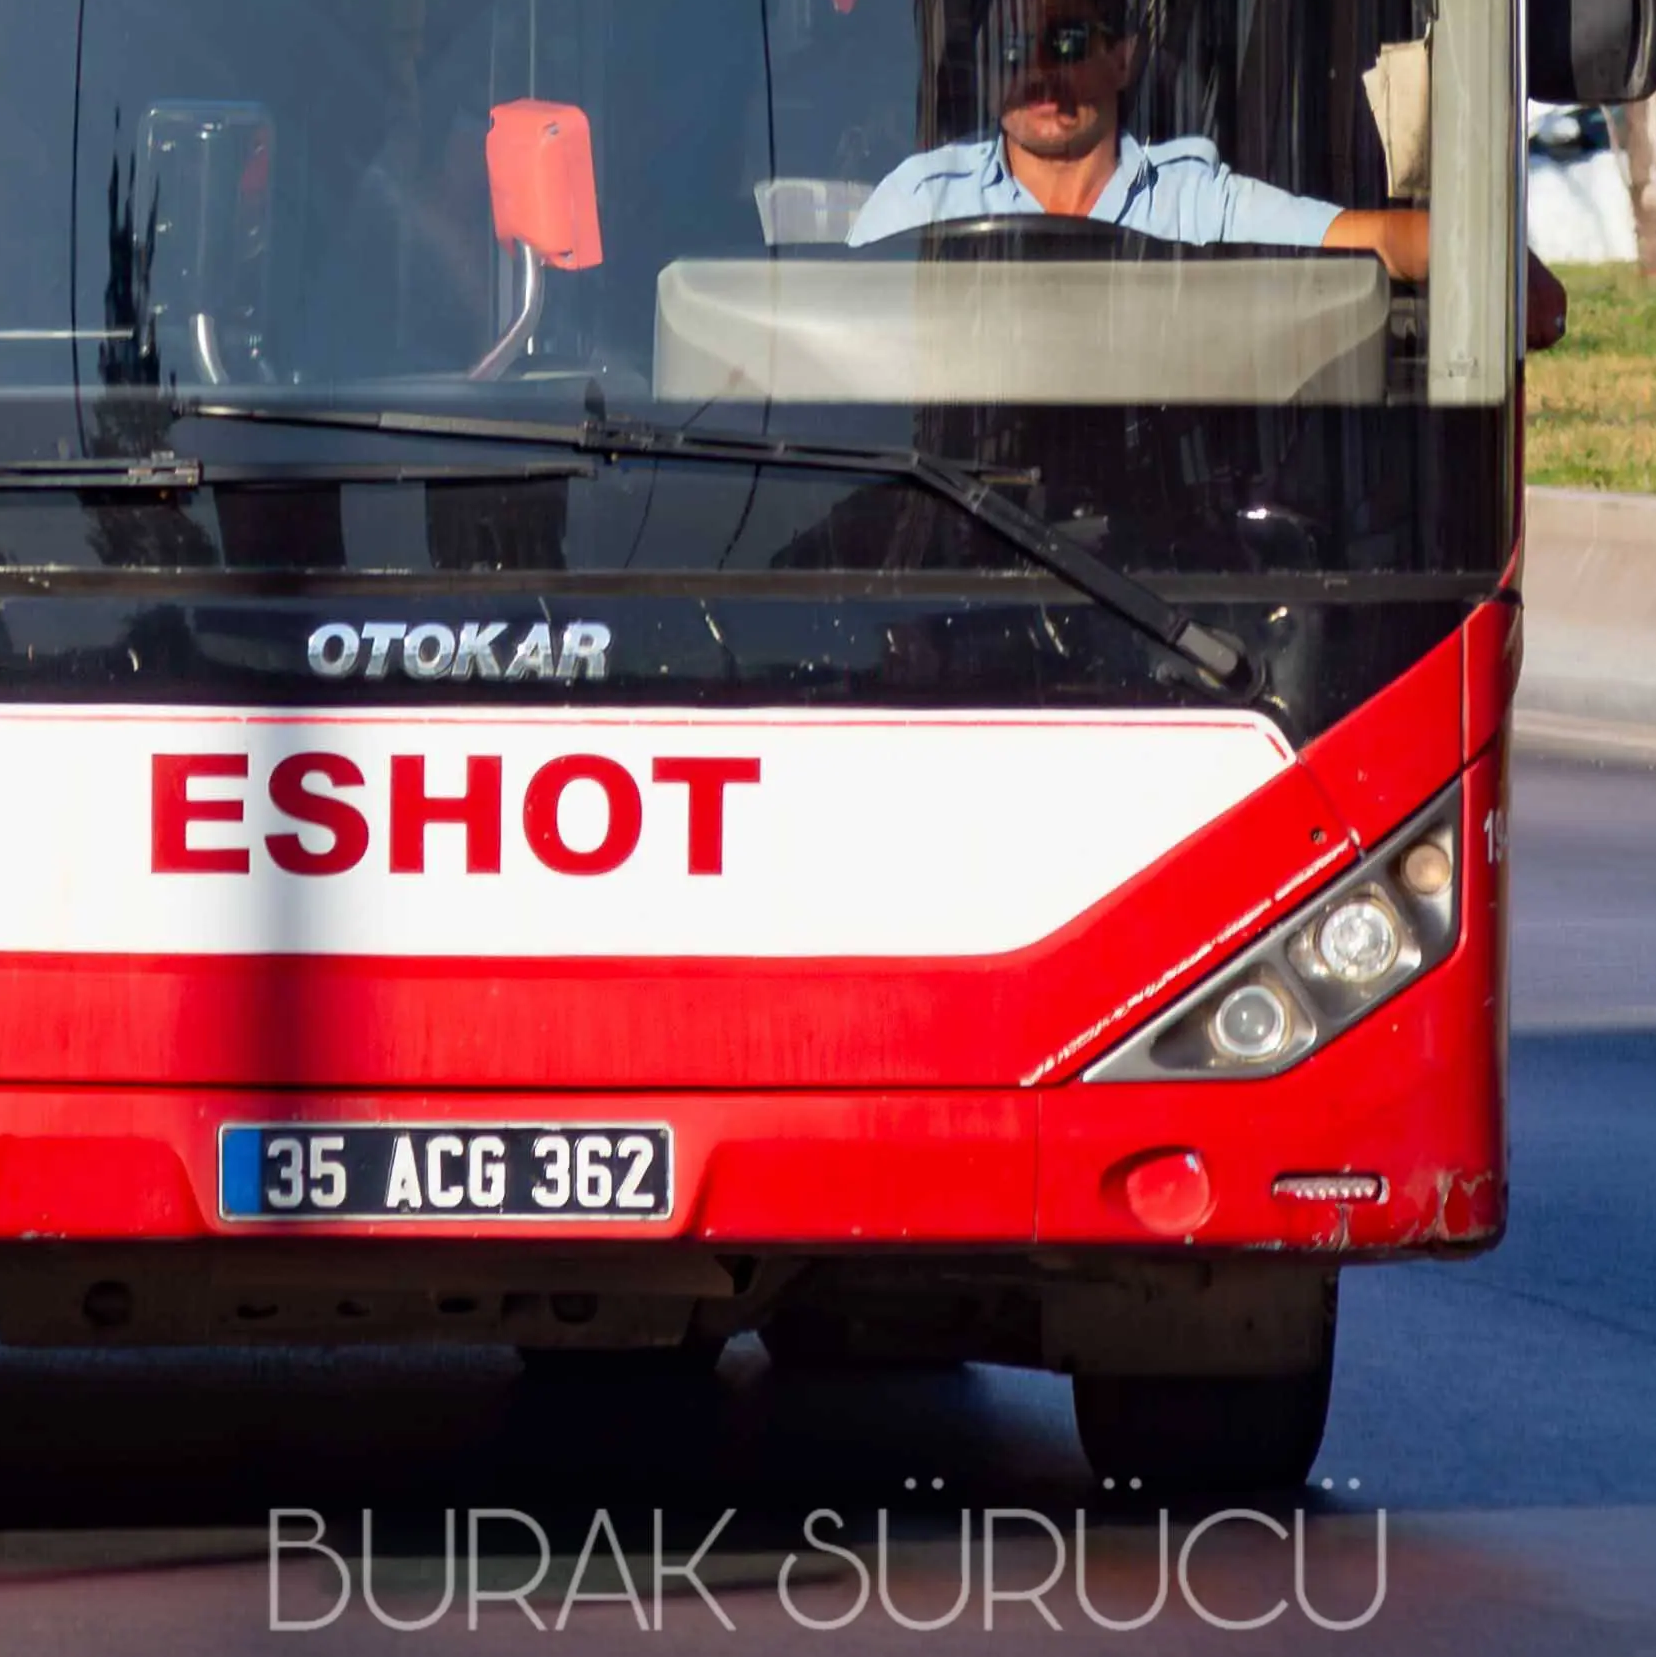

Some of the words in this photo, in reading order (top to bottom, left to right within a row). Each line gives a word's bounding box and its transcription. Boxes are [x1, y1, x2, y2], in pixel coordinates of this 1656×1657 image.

[306, 621, 612, 680] OTOKAR
[151, 752, 761, 876] ESHOT
[266, 1136, 346, 1209] 35
[385, 1135, 507, 1209] ACG
[532, 1135, 655, 1209] 362
